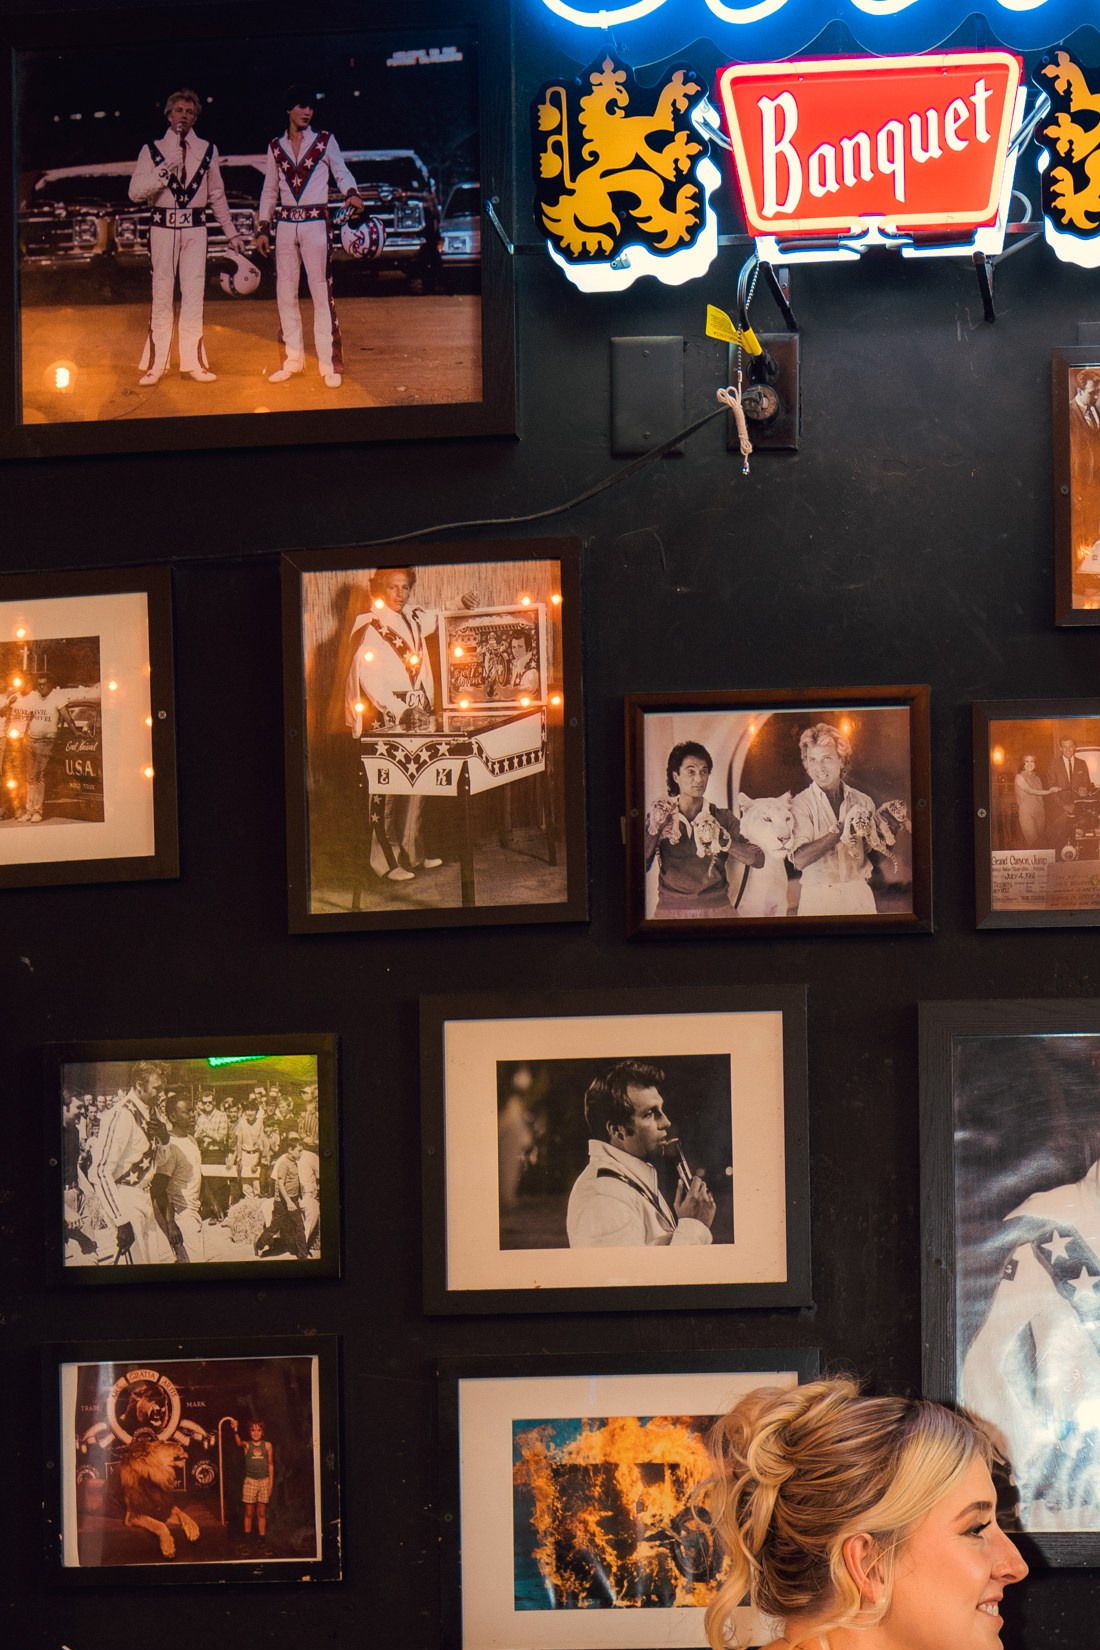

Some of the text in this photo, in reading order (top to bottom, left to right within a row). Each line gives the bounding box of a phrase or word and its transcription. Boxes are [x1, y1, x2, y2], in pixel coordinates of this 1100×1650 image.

[757, 77, 993, 218] Banquet
[992, 855, 1048, 867] Grand Canyon Jump
[128, 1371, 156, 1381] GRATIA
